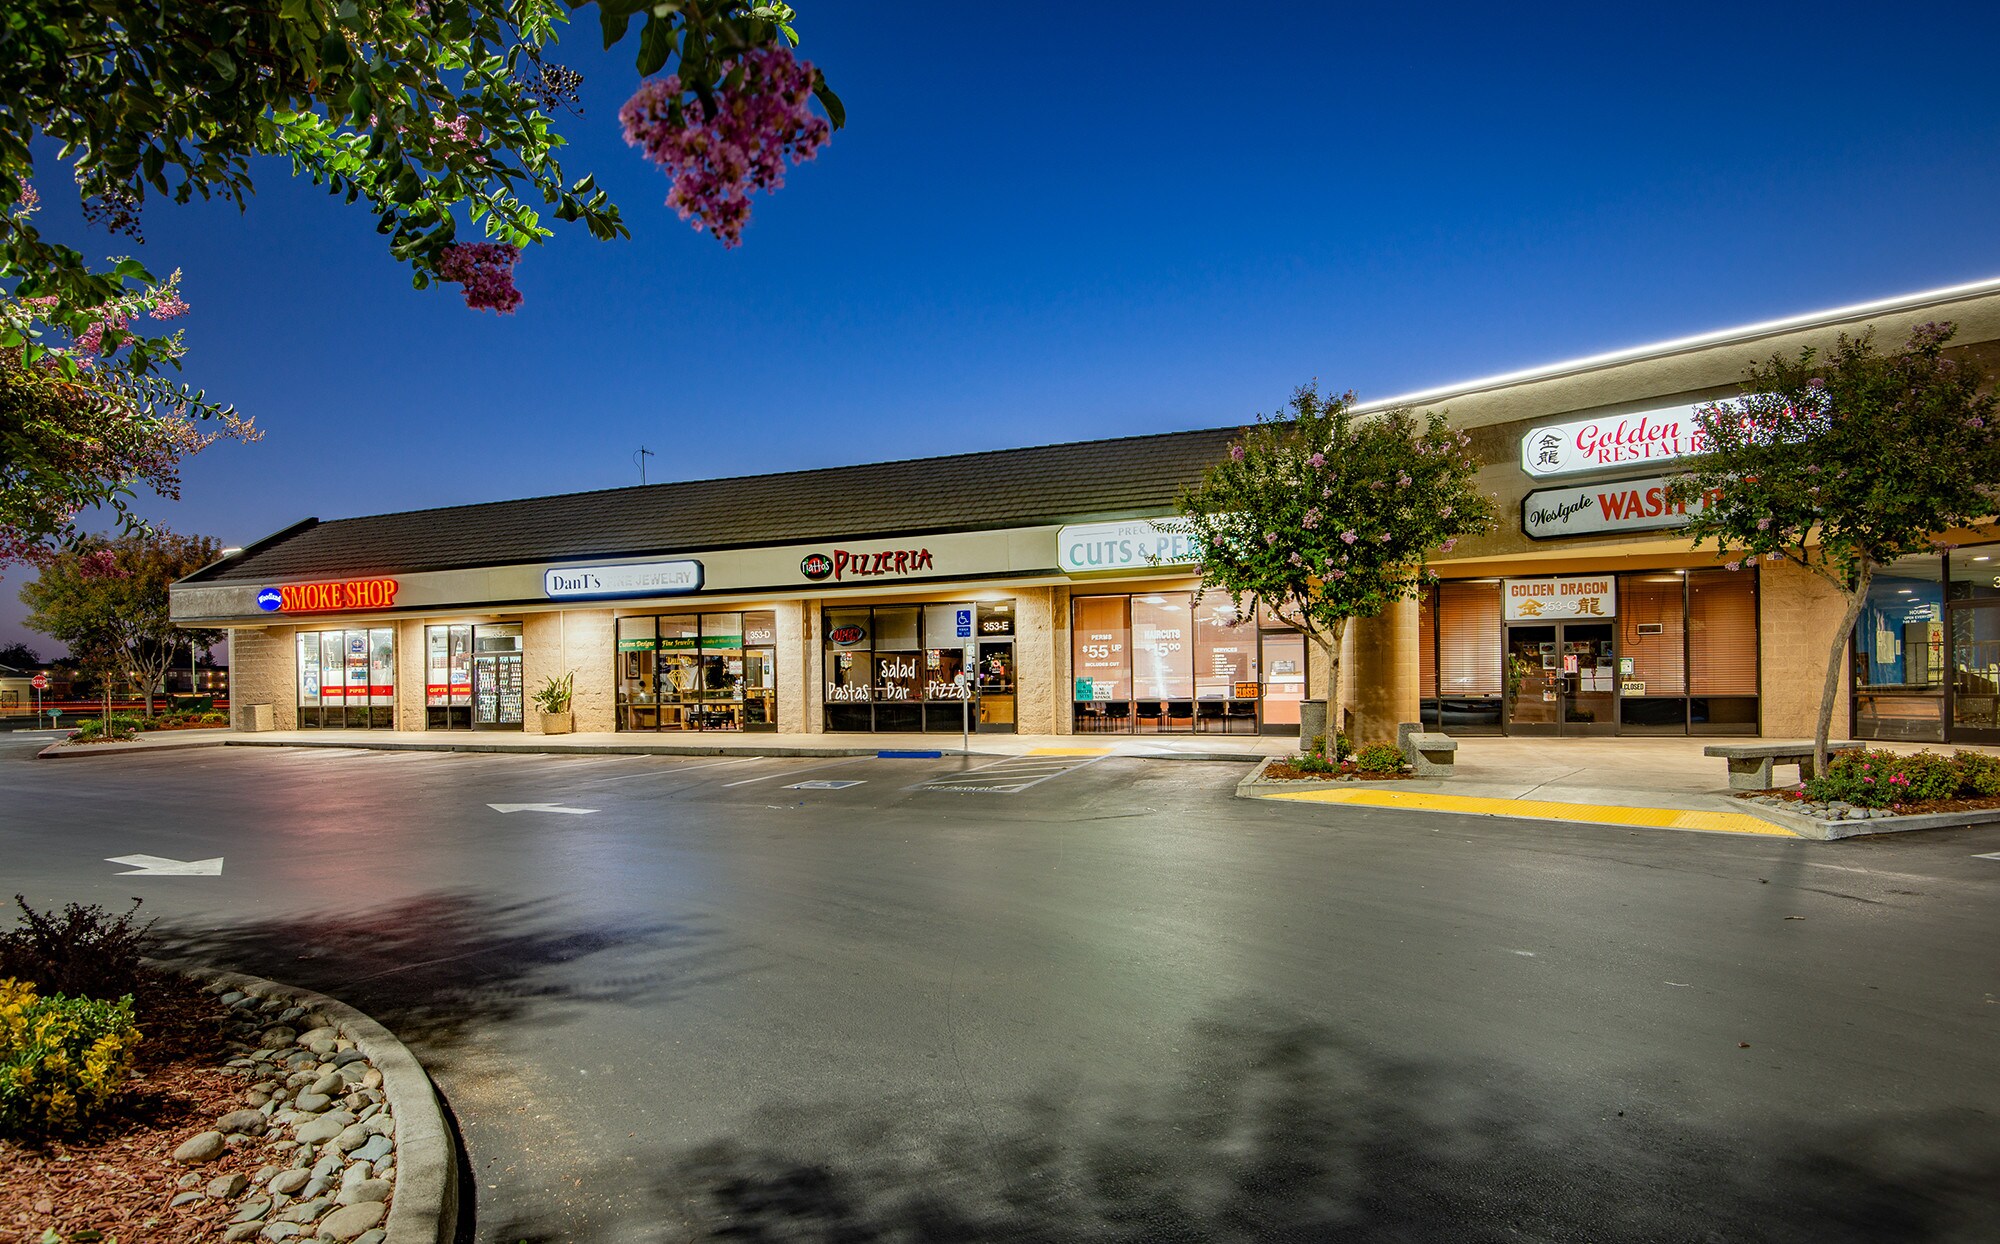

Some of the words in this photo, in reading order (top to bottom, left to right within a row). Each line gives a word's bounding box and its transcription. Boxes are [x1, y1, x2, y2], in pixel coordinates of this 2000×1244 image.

[1576, 416, 1681, 459] Golden
[1530, 493, 1594, 528] Westgate
[1598, 485, 1687, 522] WASH
[1070, 539, 1132, 566] CUTS
[1138, 542, 1148, 558] &
[553, 573, 601, 590] DanT's
[636, 572, 692, 586] JEWELRY
[1511, 584, 1554, 596] GOLDEN
[1561, 582, 1607, 595] DRAGON
[258, 592, 281, 604] Woodland
[282, 583, 341, 611] SMOKE
[346, 580, 395, 607] SHOP
[984, 621, 1009, 631] 353-E
[1144, 629, 1180, 640] HAIRCUTS
[674, 638, 695, 647] Jewelry
[1111, 644, 1122, 652] UP
[881, 657, 916, 679] Salad
[828, 681, 869, 701] Pastas
[887, 684, 910, 700] Bar
[928, 681, 972, 700] Pizzas
[1236, 688, 1258, 697] CLOSED
